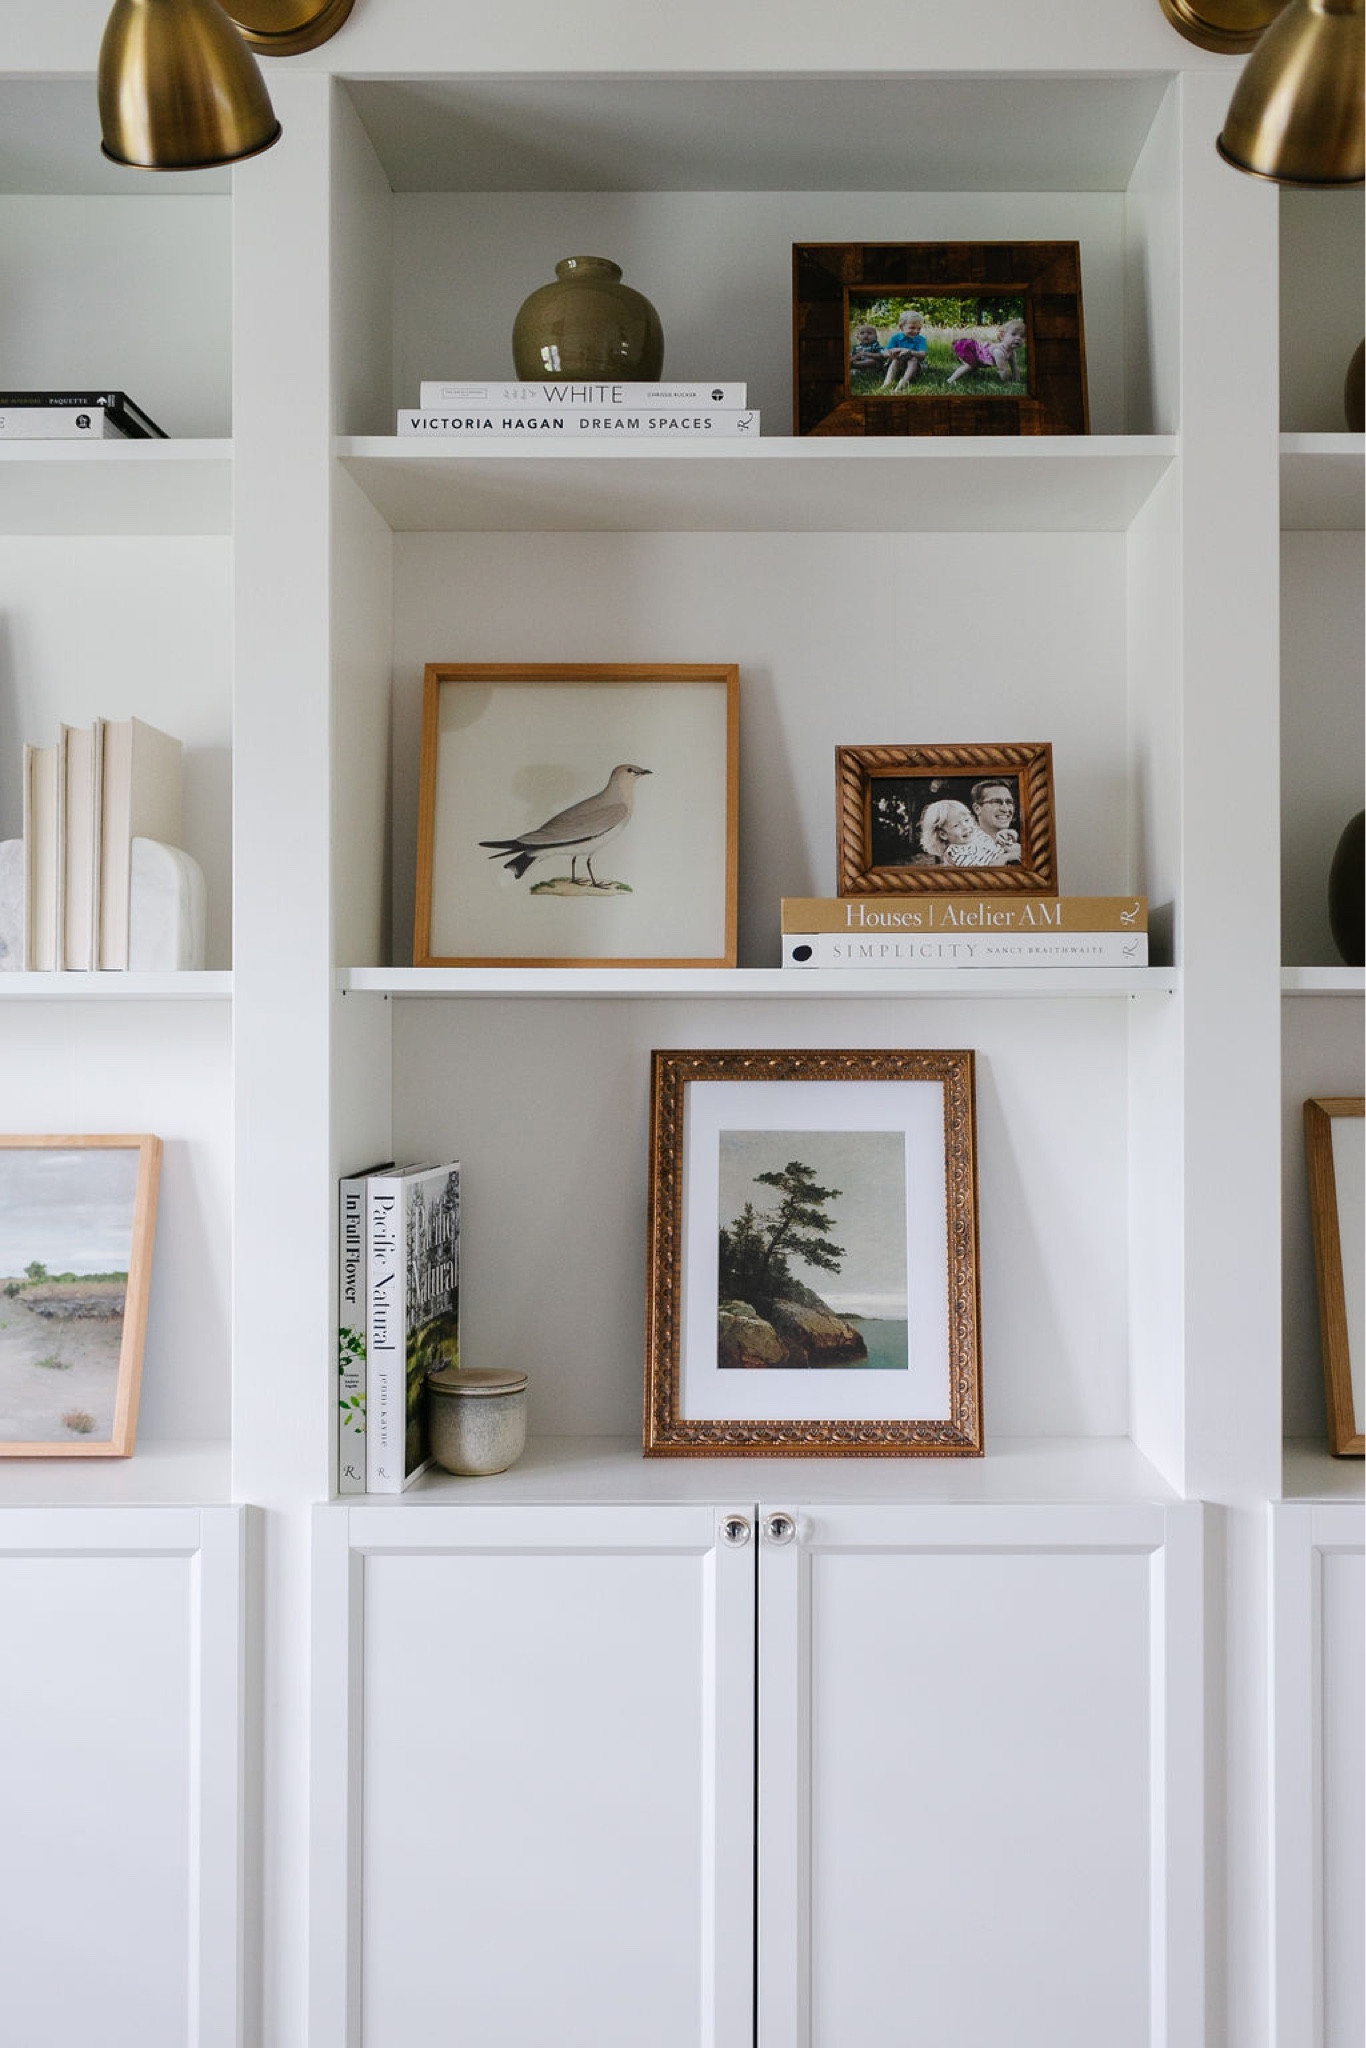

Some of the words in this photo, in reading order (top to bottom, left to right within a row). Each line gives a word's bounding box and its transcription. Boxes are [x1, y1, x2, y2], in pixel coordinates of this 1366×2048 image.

[543, 385, 623, 404] WHITE
[411, 418, 493, 429] VICTORIA
[502, 418, 564, 429] HAGAN
[579, 418, 640, 429] DREAM
[648, 418, 713, 429] SPACES
[846, 904, 923, 927] Houses
[940, 903, 1016, 927] Atelier
[1018, 903, 1063, 926] AM
[832, 943, 977, 958] SIMPLICITY
[986, 946, 1022, 954] NANCY
[1028, 946, 1104, 954] BRAITHWAITE
[346, 1194, 361, 1210] In
[346, 1214, 361, 1244] Full
[373, 1196, 396, 1265] Pacific
[345, 1248, 361, 1304] Flower
[373, 1274, 396, 1350] Natural
